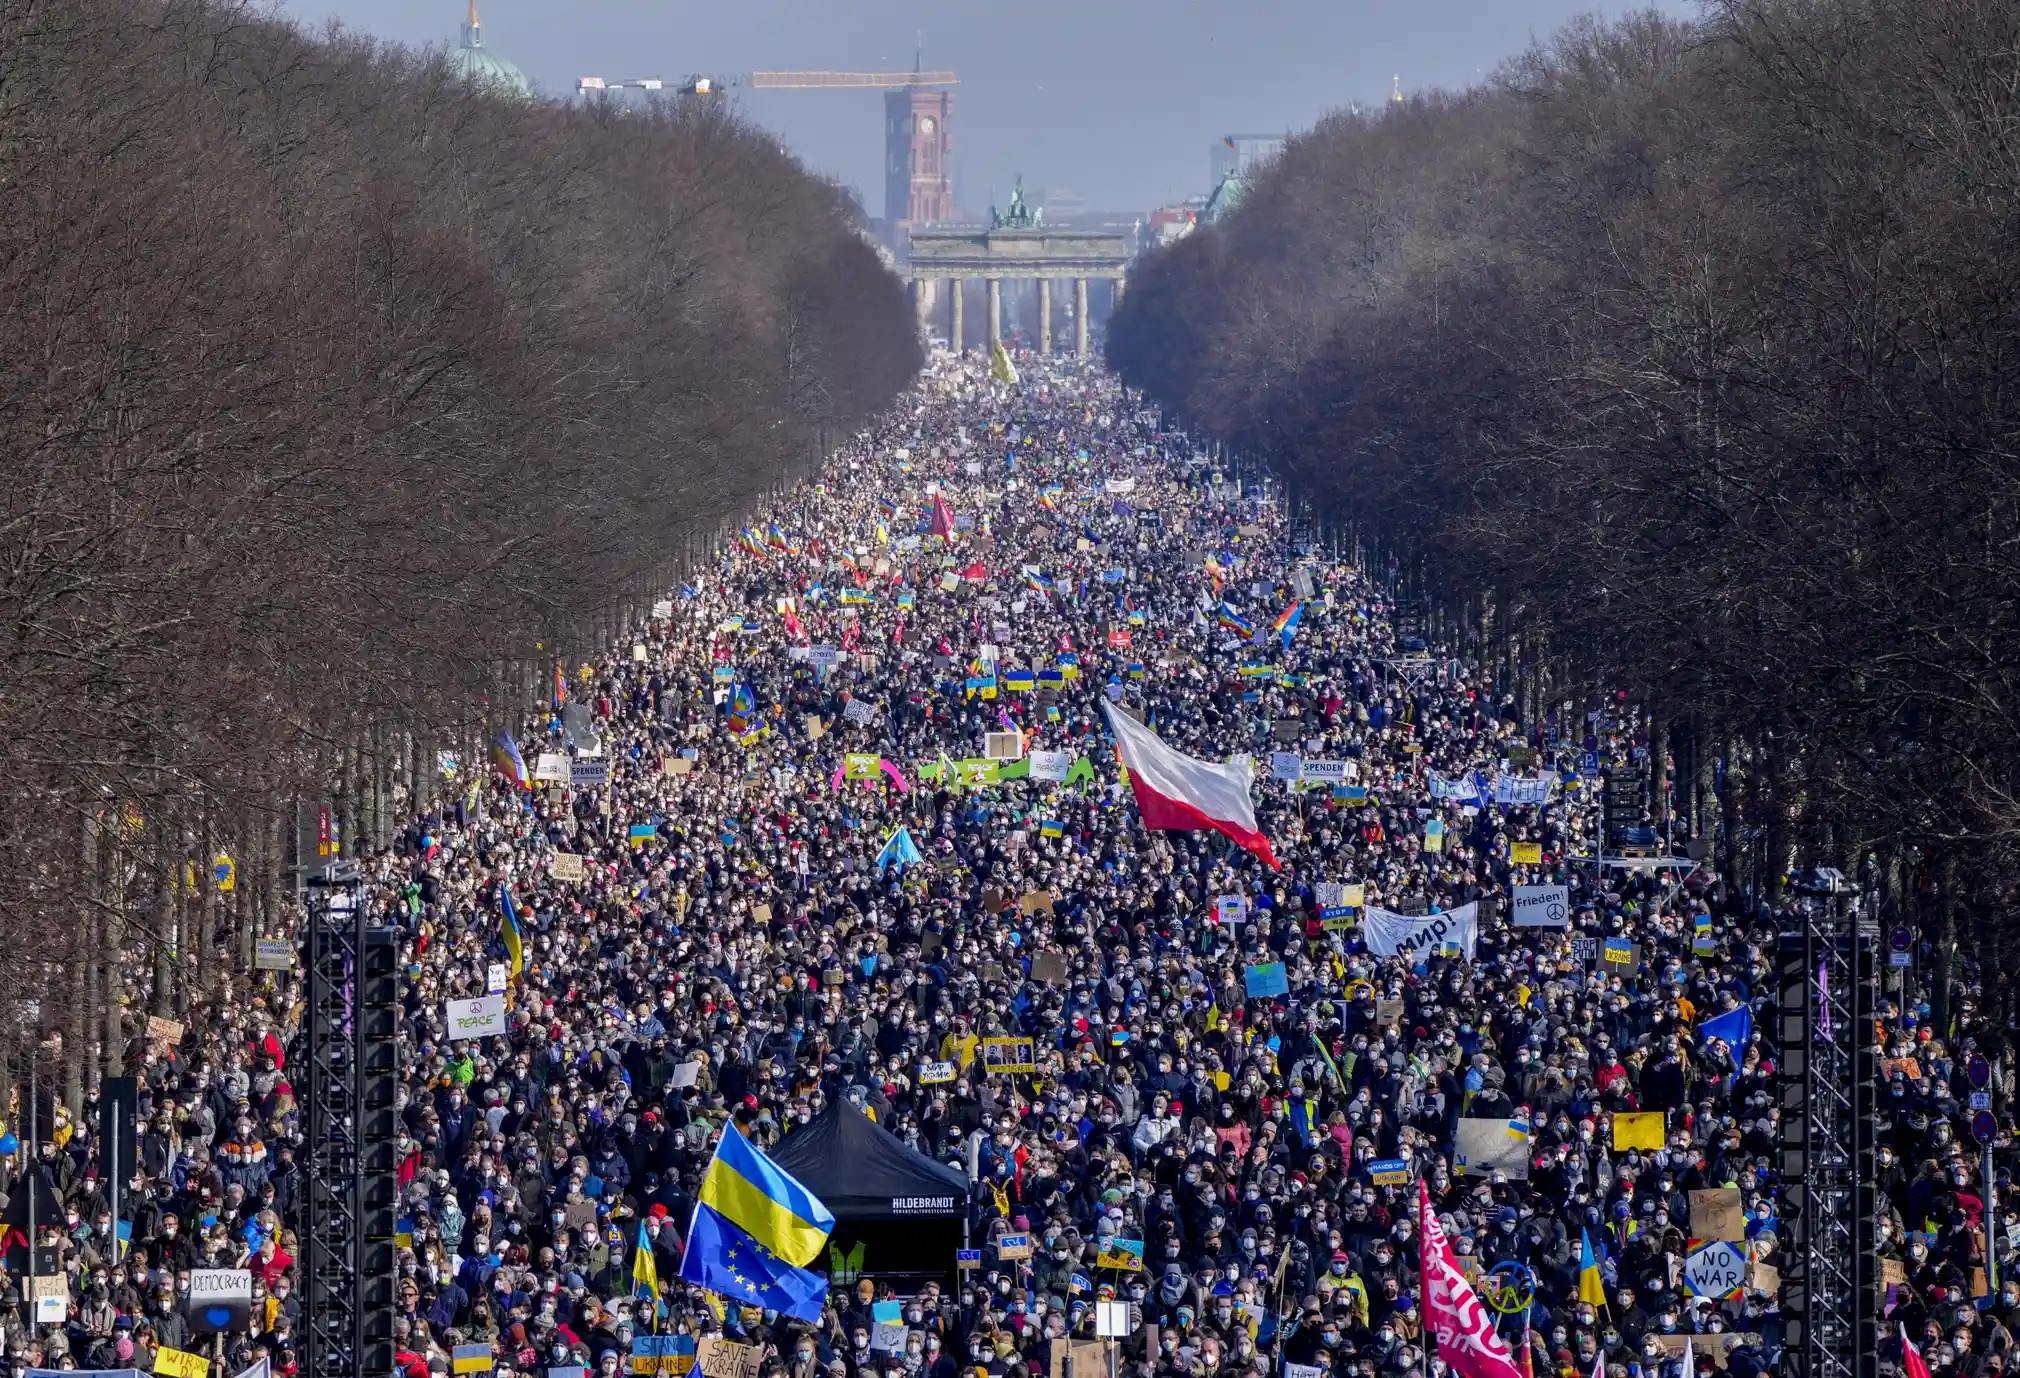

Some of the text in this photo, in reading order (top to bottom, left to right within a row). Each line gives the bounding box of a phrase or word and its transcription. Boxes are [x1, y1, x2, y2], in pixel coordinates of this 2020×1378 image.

[572, 767, 605, 775] SPENDEN
[1304, 763, 1344, 772] SPENDEN
[1517, 890, 1565, 908] Frieden!
[1325, 908, 1347, 917] STOP
[1332, 917, 1349, 926] WAR
[1571, 939, 1595, 949] STOP
[1606, 949, 1631, 963] UKRAINE
[456, 1013, 497, 1029] PEACE
[893, 1197, 954, 1208] HILDEBRANDT
[1703, 1250, 1730, 1268] NO
[193, 1274, 249, 1292] DEMOCRACY
[1692, 1268, 1738, 1289] WAR
[166, 1350, 194, 1367] WIR
[708, 1341, 752, 1363] SAVE
[635, 1357, 683, 1372] UKRAINE
[700, 1355, 758, 1378] UKRAINE
